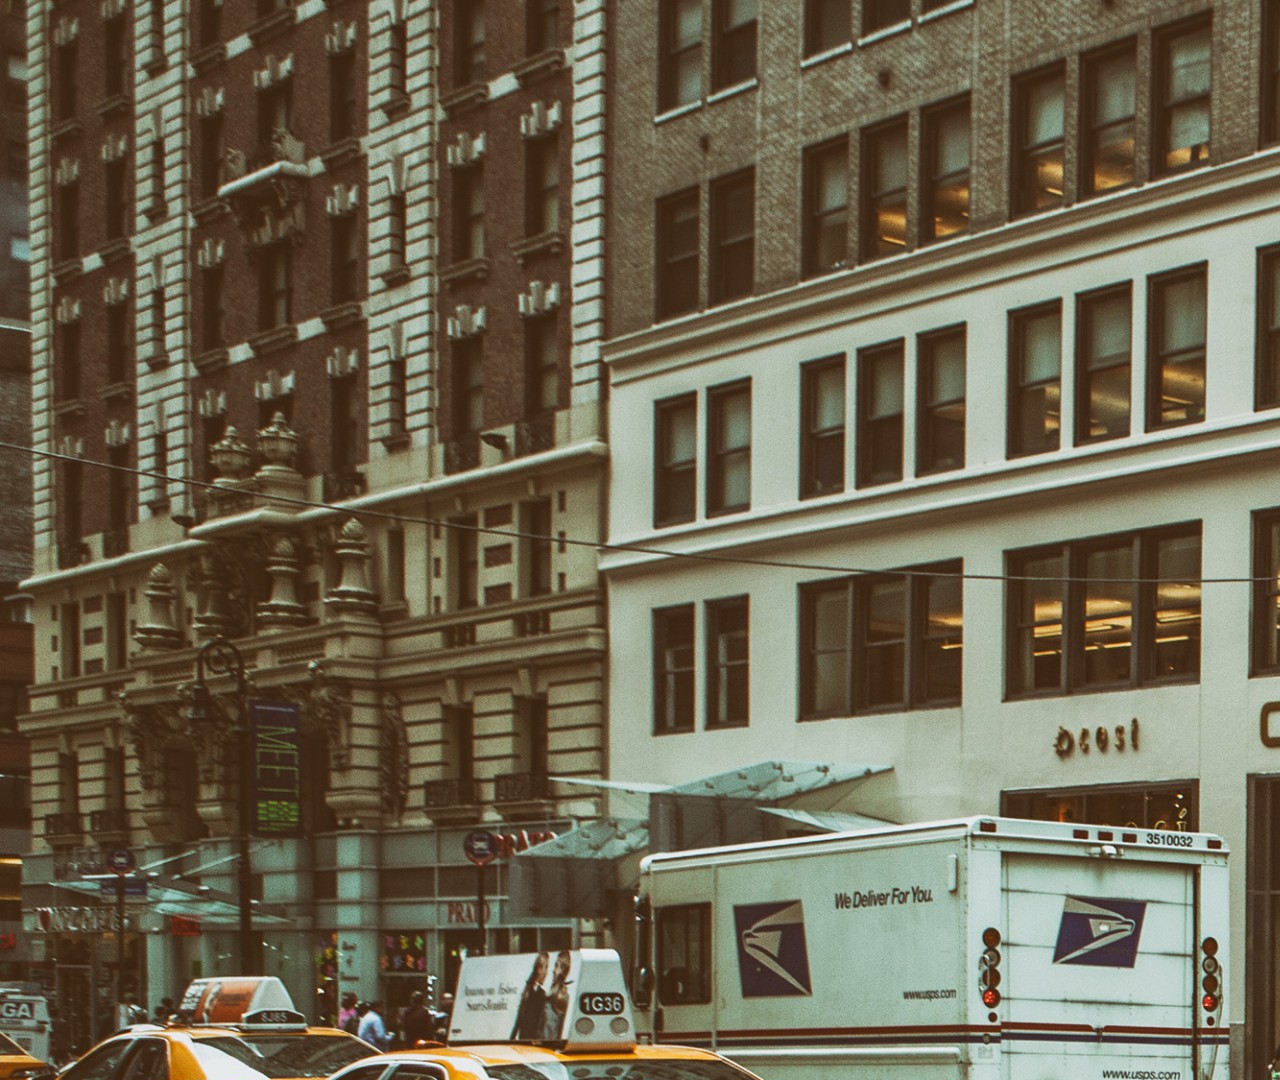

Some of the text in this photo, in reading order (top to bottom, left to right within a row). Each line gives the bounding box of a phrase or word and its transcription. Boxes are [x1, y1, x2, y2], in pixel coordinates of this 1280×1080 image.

[256, 725, 299, 799] MEET
[1146, 833, 1193, 848] 3510032
[835, 885, 934, 909] We Deliver For You.
[903, 989, 957, 1002] www.usps.com
[583, 996, 622, 1012] 1G36
